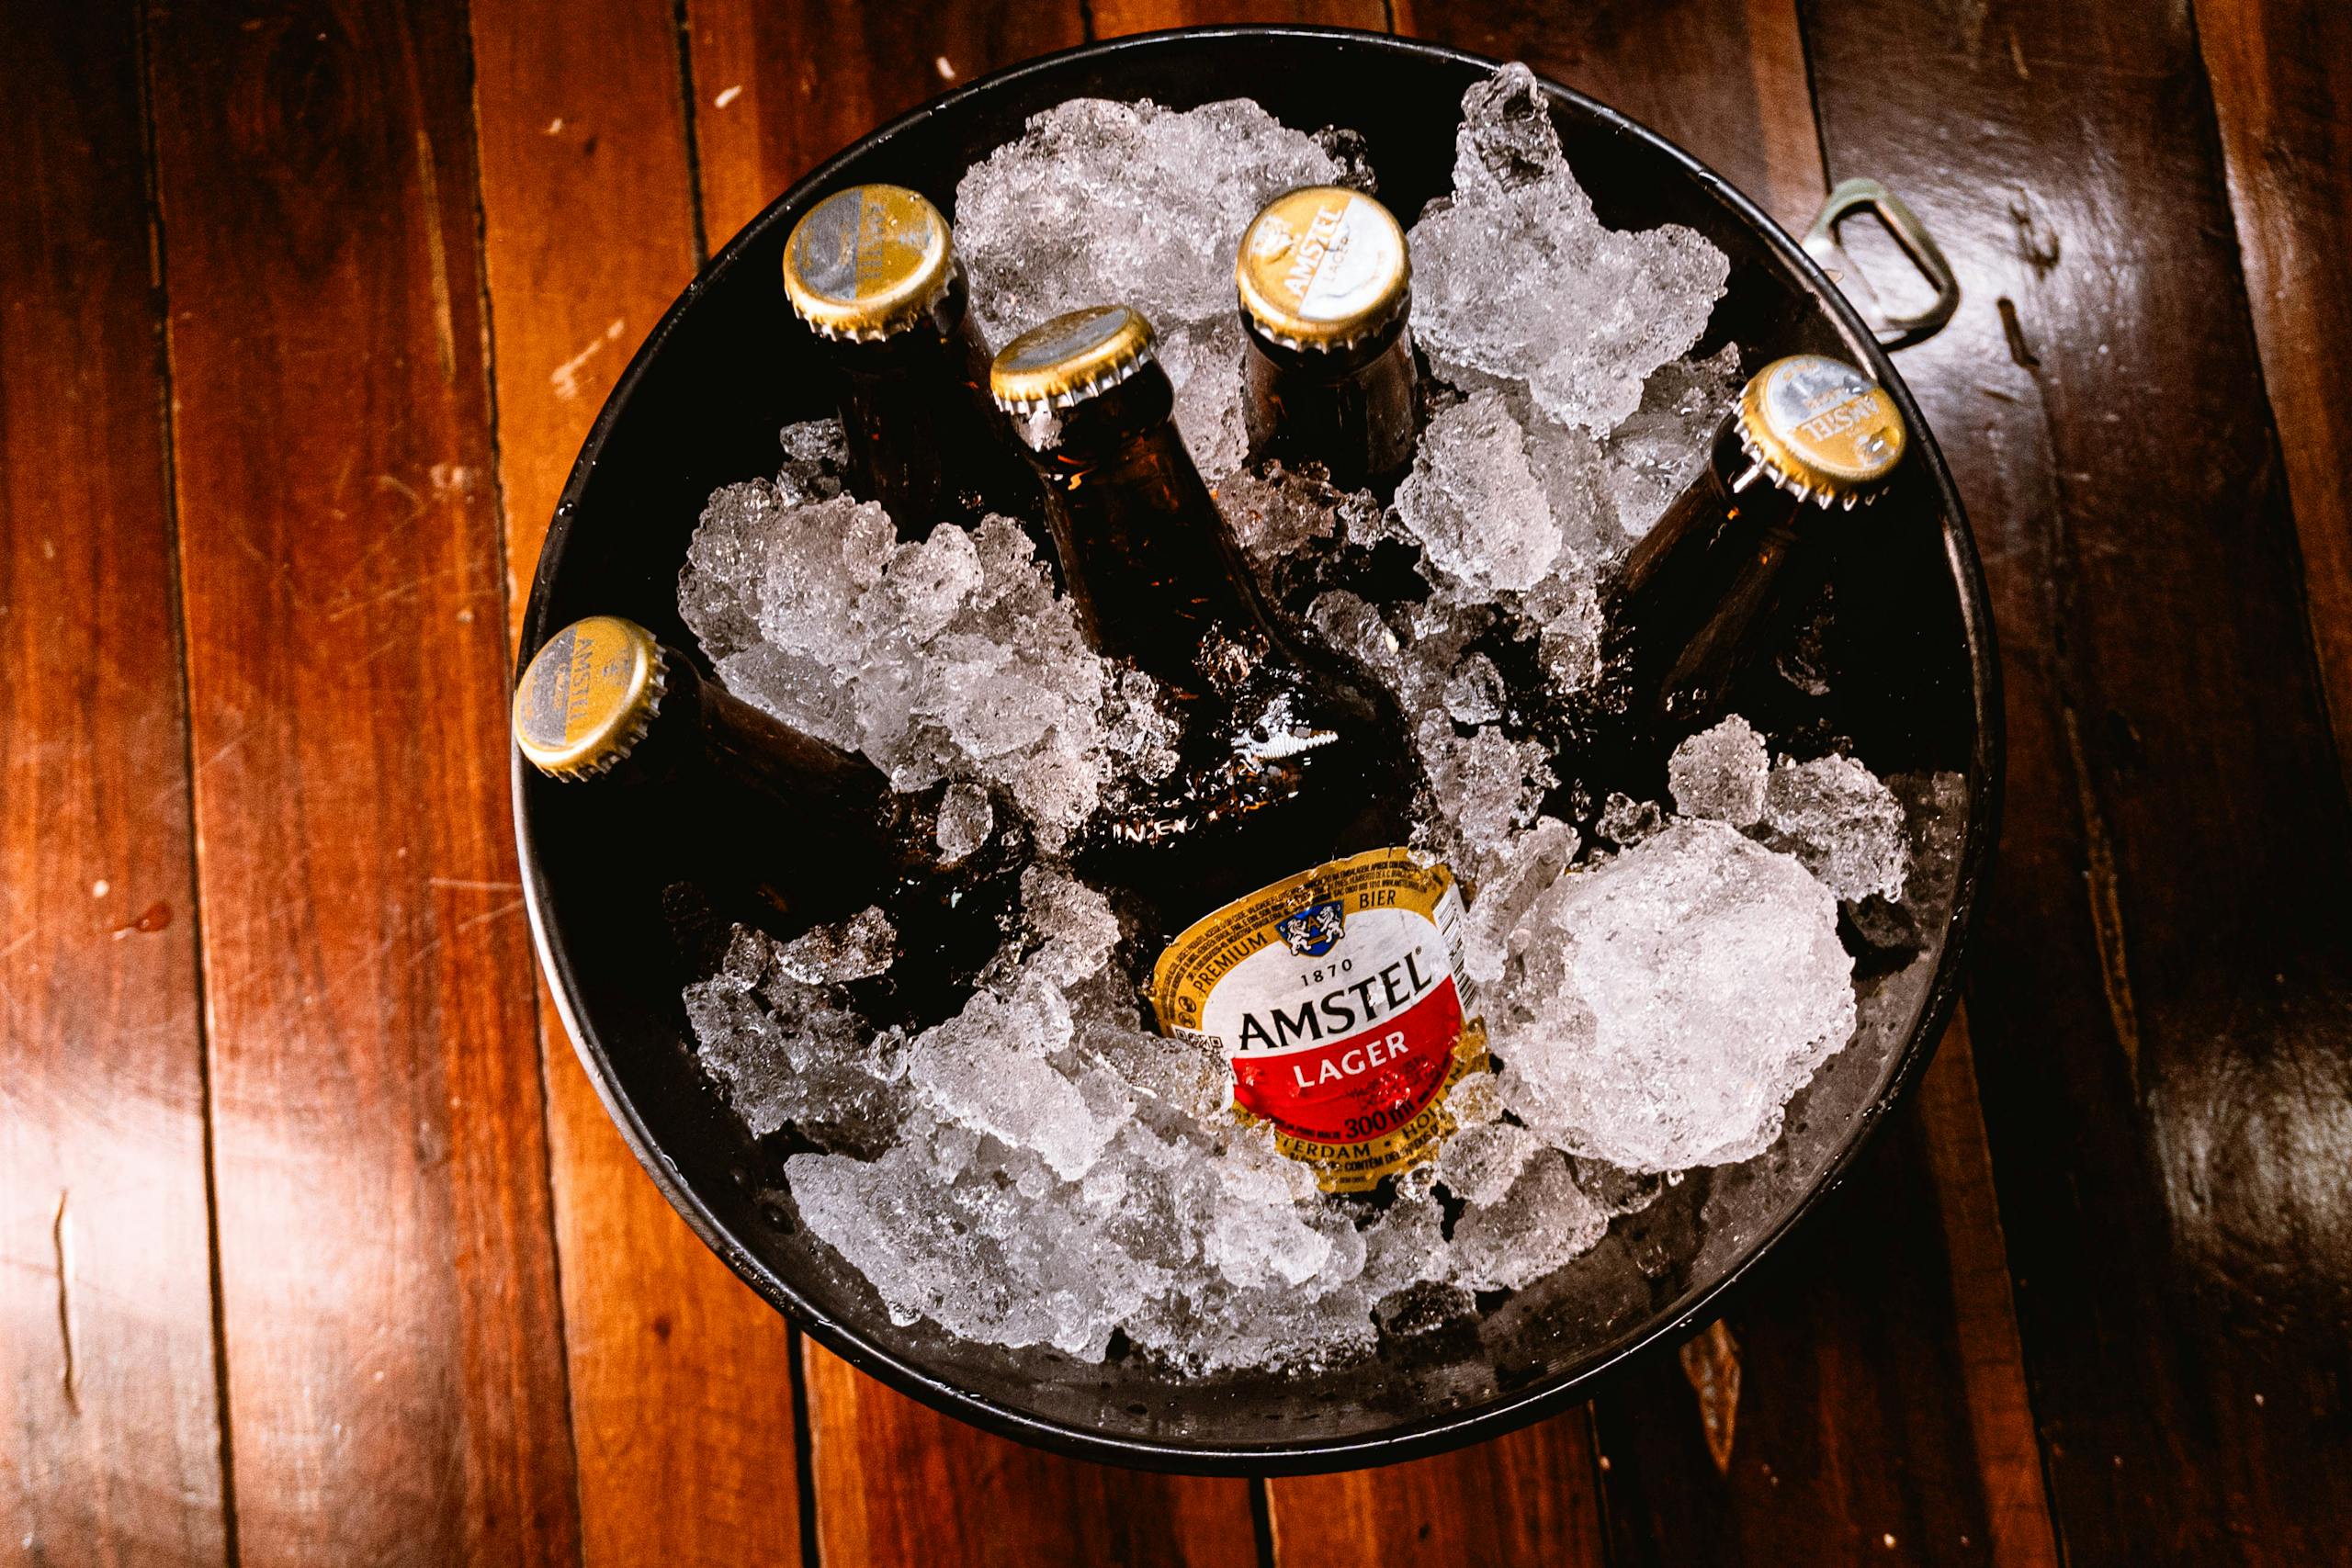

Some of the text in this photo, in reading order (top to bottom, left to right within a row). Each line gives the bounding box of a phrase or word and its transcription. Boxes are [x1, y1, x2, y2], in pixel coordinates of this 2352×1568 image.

[1282, 207, 1340, 299] AMSTEL
[1804, 397, 1881, 442] AMSTEL
[571, 638, 595, 722] AMSTEL
[1193, 931, 1268, 994] PREMIUM
[1360, 888, 1396, 909] BIER
[1301, 958, 1352, 987] 1870
[1239, 953, 1432, 1051] AMSTEL
[1293, 1031, 1408, 1088] LAGER
[1344, 1111, 1386, 1139] 300
